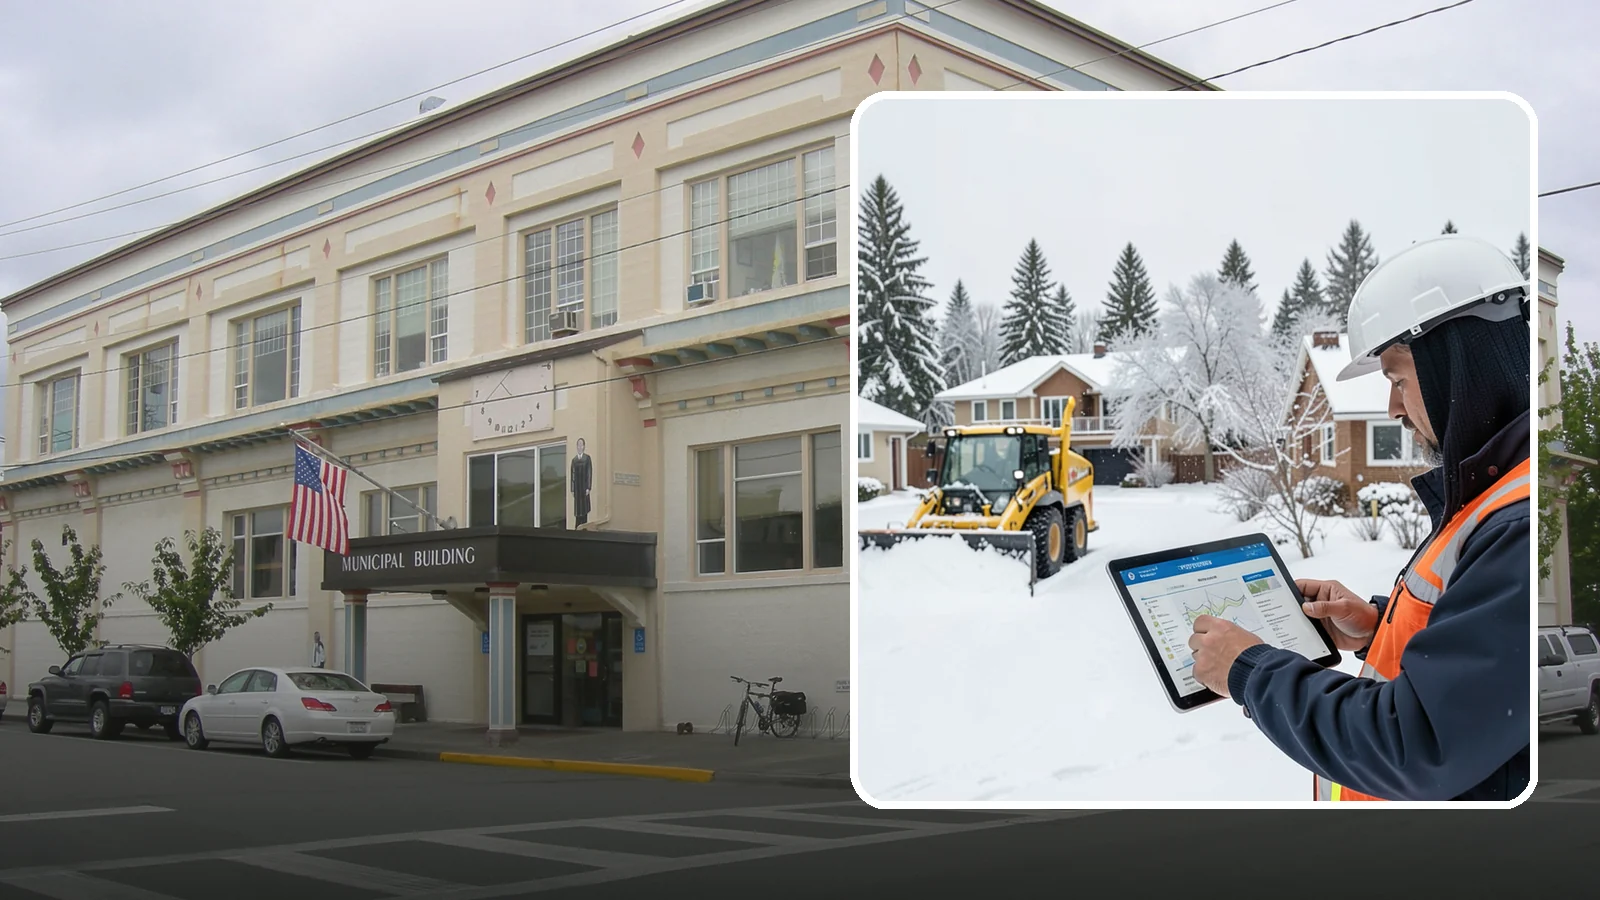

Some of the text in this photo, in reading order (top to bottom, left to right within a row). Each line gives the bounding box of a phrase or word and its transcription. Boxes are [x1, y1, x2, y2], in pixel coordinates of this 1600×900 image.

[546, 361, 551, 370] 6
[475, 390, 479, 398] 7
[536, 402, 540, 410] 4
[481, 407, 485, 415] 8
[487, 417, 492, 426] 9
[528, 414, 533, 422] 3
[494, 424, 500, 432] 10
[521, 420, 525, 428] 2
[507, 425, 513, 433] 12
[342, 546, 475, 572] MUNICIPAL BUILDING
